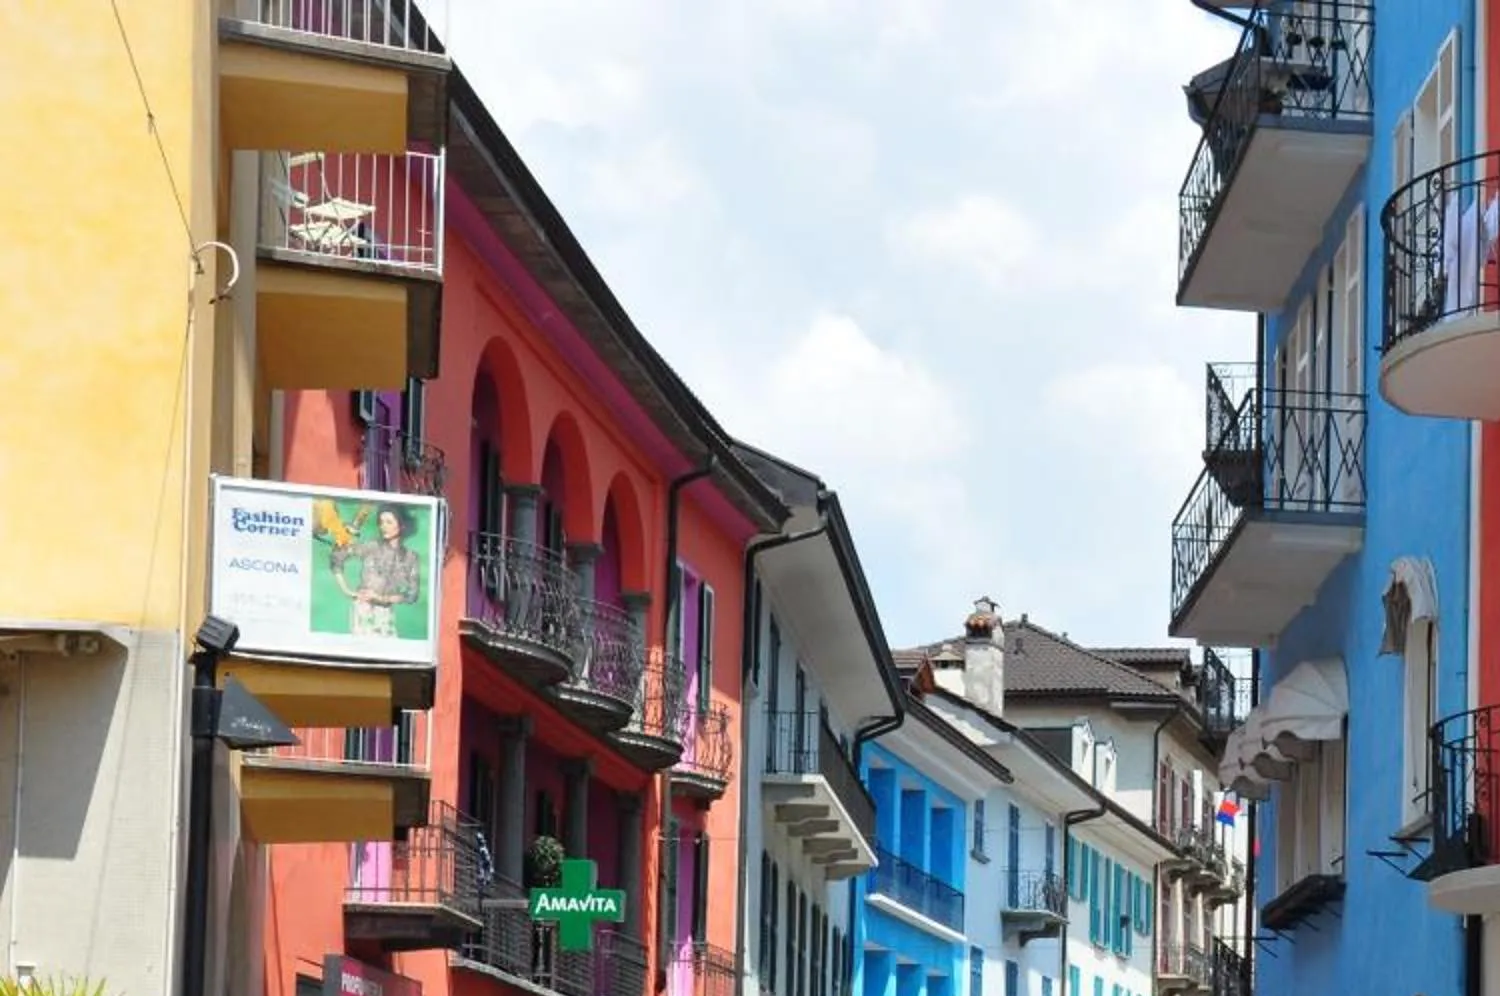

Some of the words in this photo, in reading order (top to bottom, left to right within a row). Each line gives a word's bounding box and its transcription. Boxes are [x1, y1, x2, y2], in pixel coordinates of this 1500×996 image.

[232, 507, 304, 526] Fashion
[233, 517, 300, 537] Corner
[229, 557, 298, 574] ASCONA
[535, 893, 617, 914] AMAVITA
